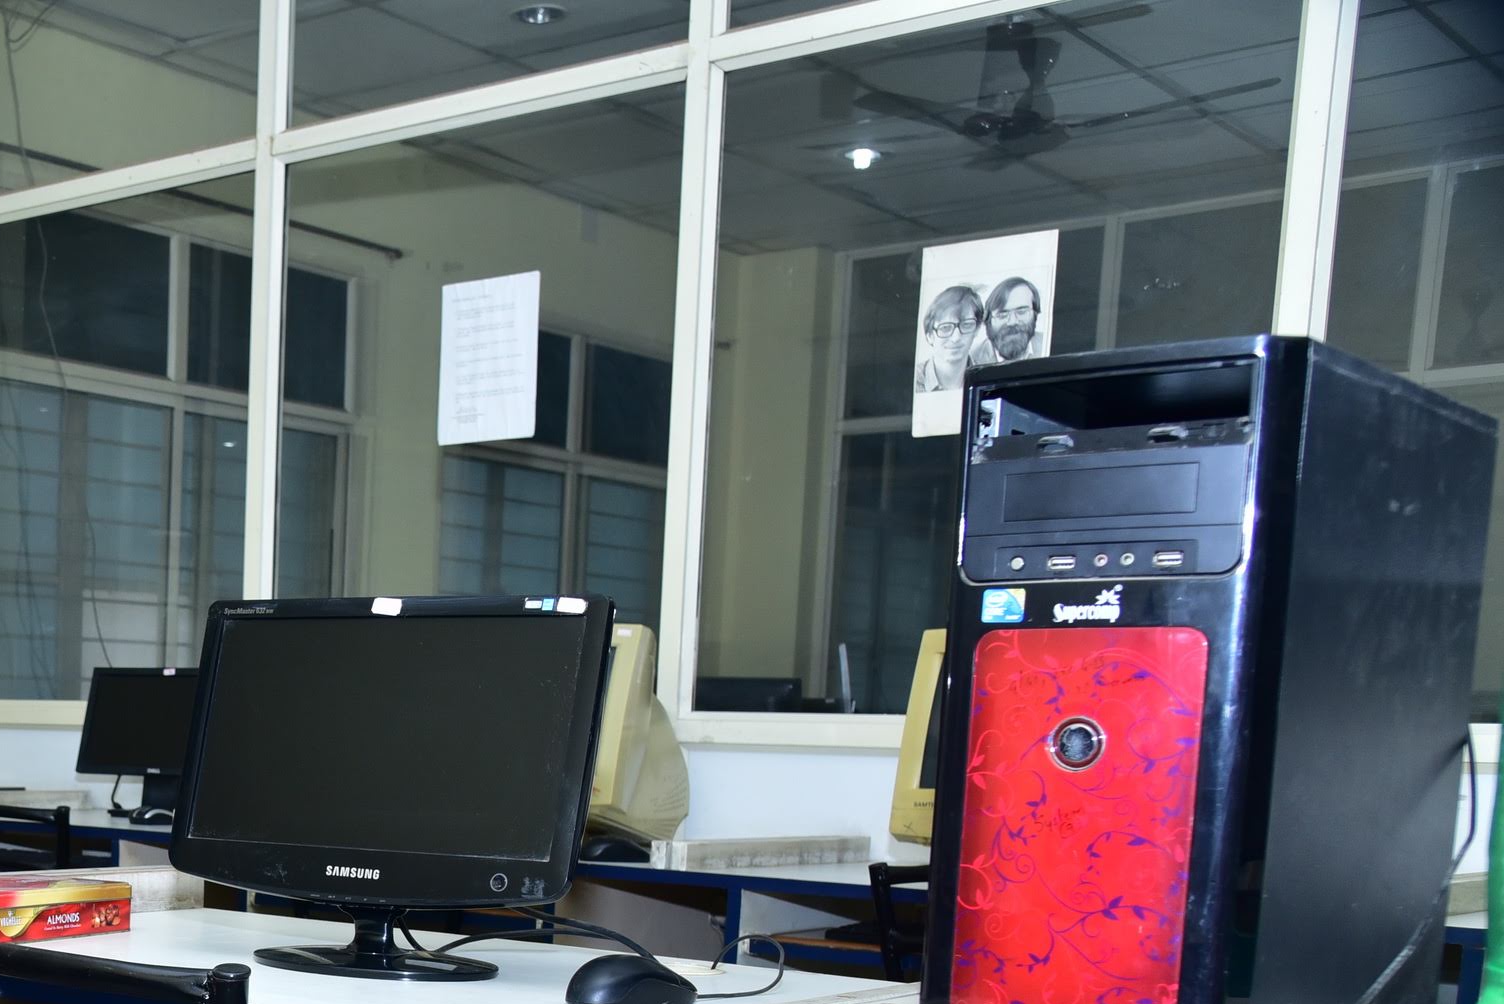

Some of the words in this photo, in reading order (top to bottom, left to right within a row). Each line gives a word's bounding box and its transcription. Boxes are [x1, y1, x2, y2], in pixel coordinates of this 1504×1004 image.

[1053, 603, 1121, 623] Supercomp
[325, 865, 381, 880] SAMSUNG
[46, 912, 80, 925] ALMONDS
